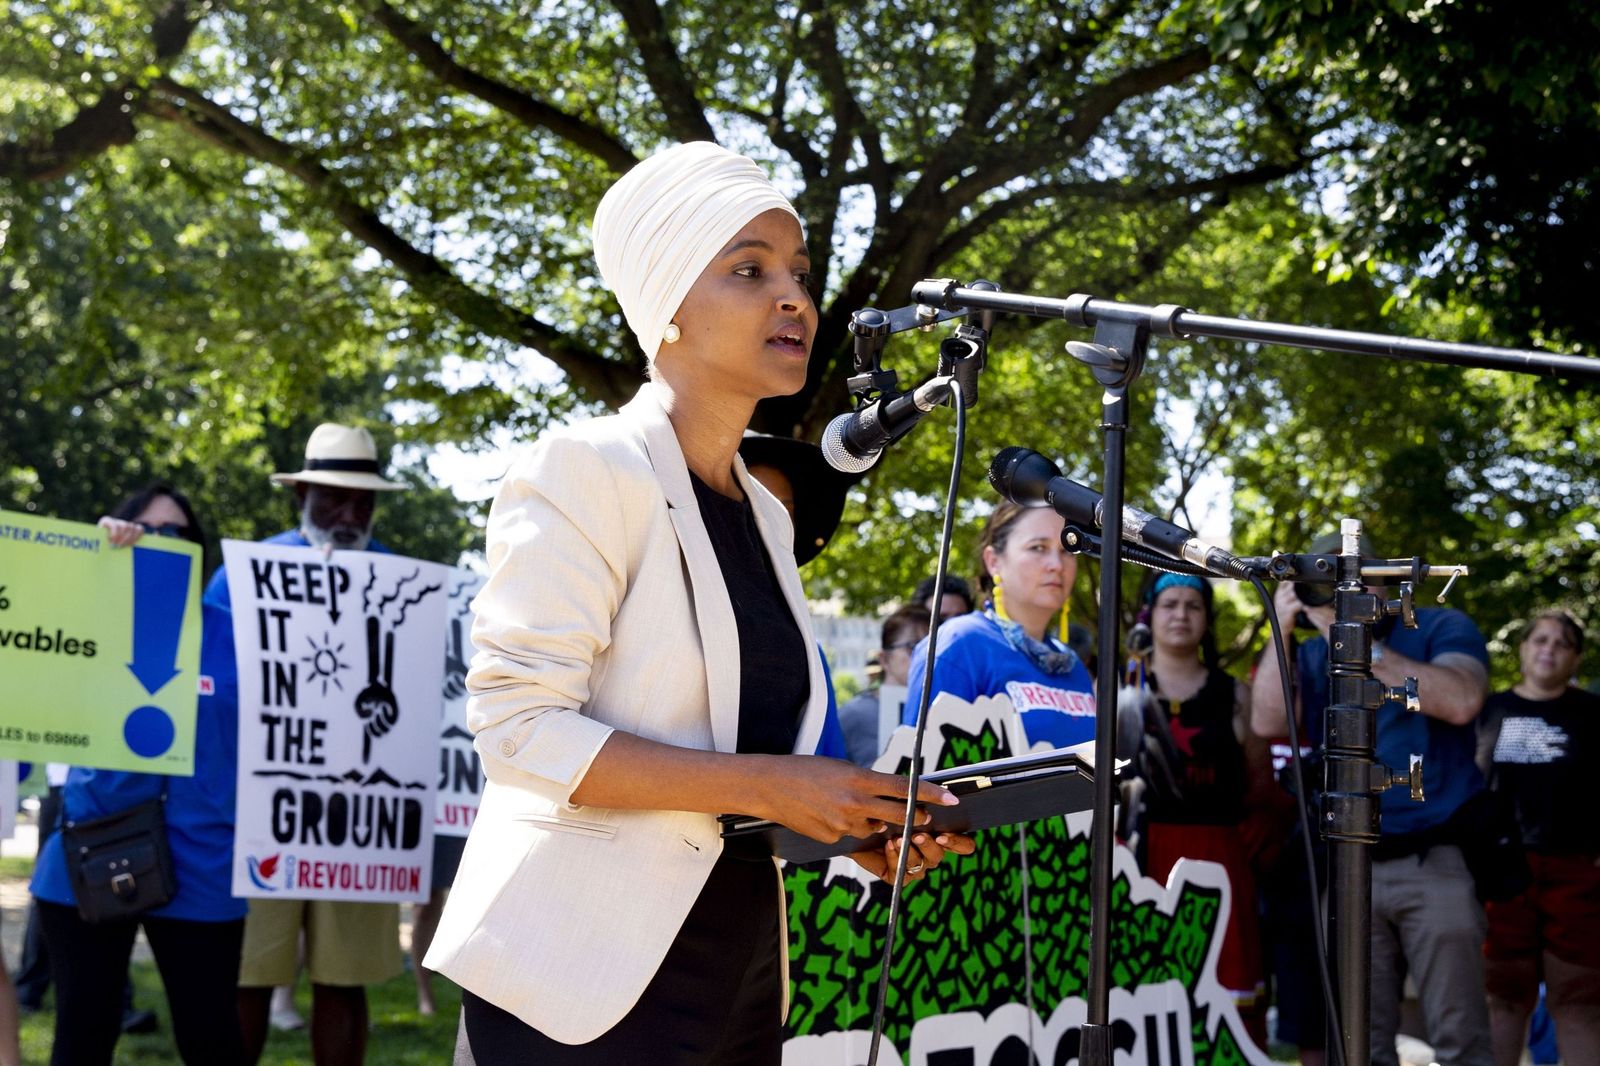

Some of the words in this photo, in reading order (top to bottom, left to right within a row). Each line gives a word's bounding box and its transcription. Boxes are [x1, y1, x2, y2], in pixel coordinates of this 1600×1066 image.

[0, 525, 31, 541] TER
[34, 530, 100, 553] ACTION!
[250, 558, 350, 622] KEEP
[257, 607, 291, 653] IT
[261, 659, 297, 709] IN
[27, 731, 41, 743] to
[260, 712, 327, 765] THE
[271, 788, 422, 850] GROUND
[298, 859, 421, 893] REVOLUTION
